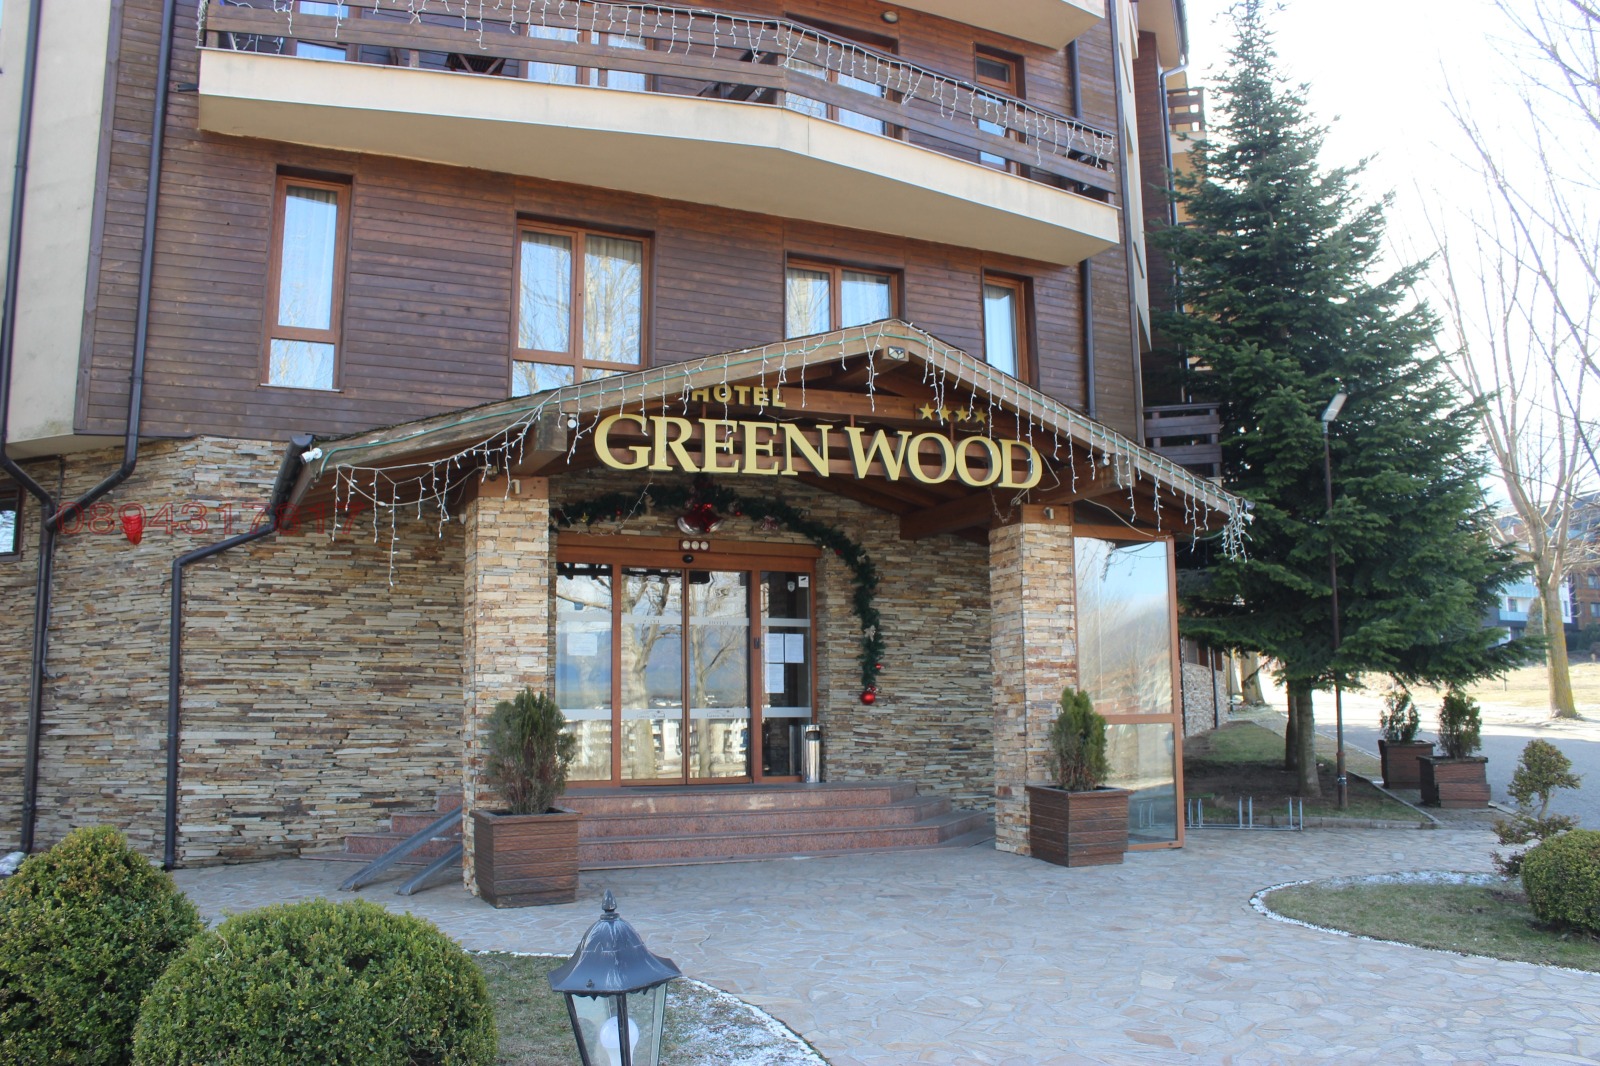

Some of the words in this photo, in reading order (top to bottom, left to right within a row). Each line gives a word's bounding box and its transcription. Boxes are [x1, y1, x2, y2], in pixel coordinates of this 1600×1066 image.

[691, 385, 786, 408] HOTEL
[594, 413, 833, 477] GREEN
[843, 426, 1043, 489] WOOD
